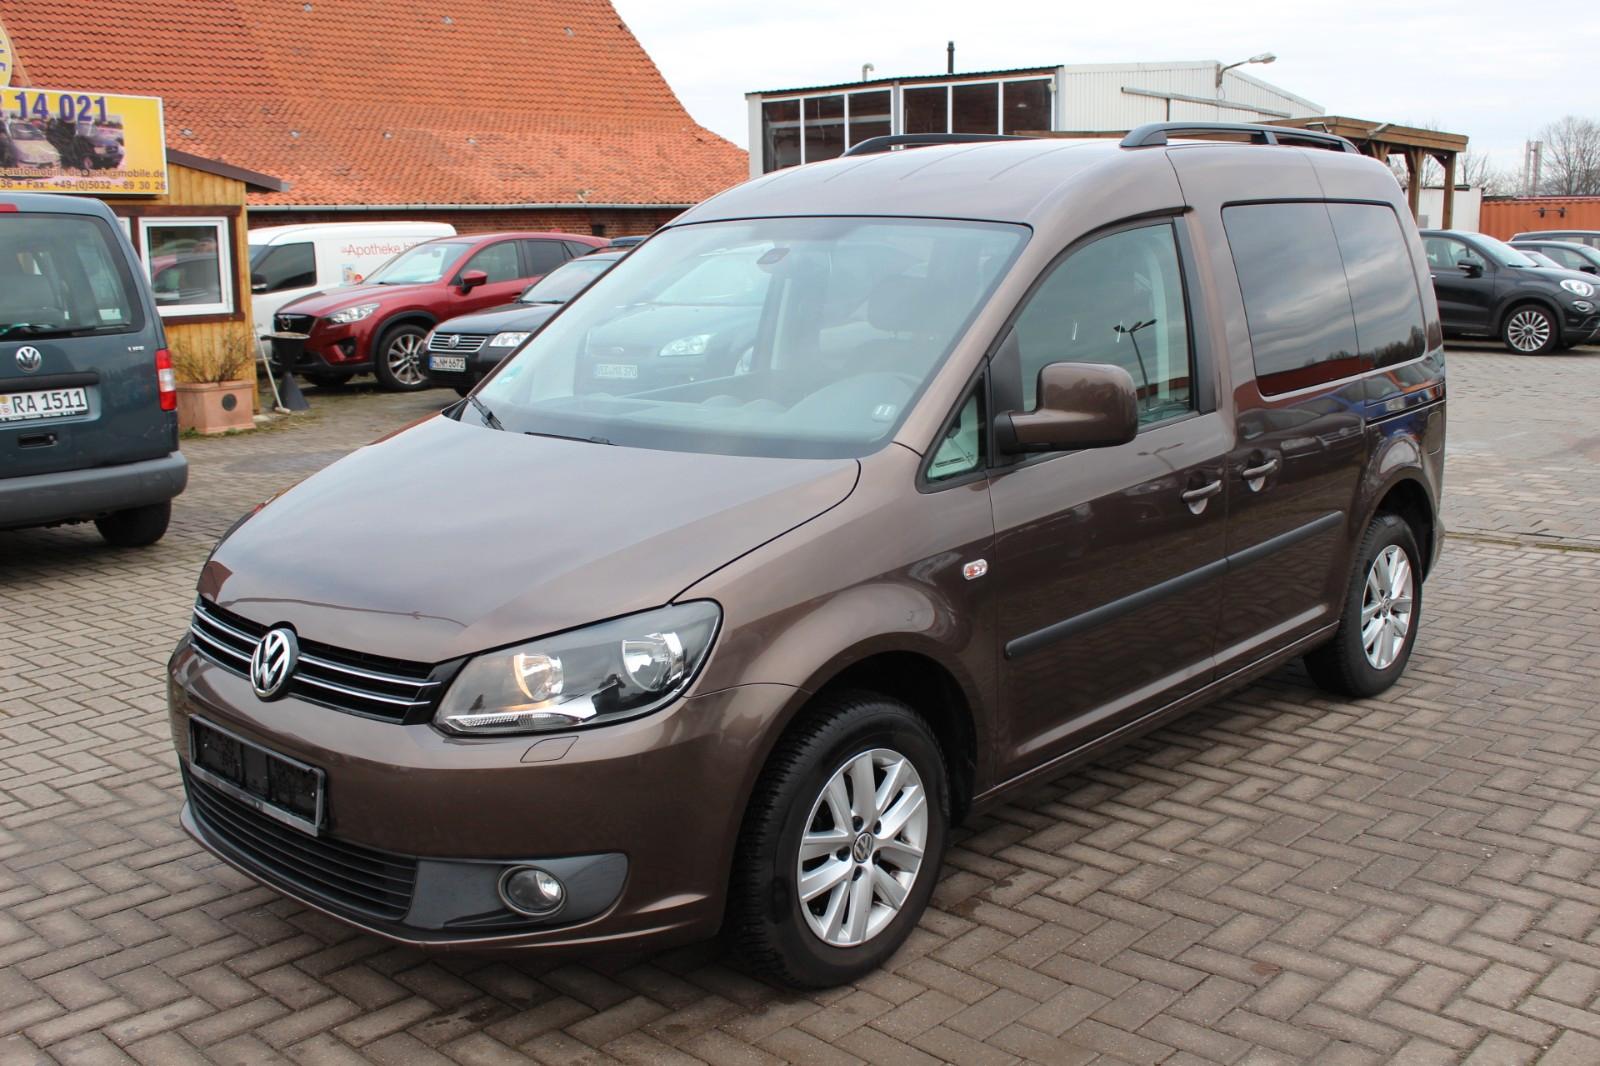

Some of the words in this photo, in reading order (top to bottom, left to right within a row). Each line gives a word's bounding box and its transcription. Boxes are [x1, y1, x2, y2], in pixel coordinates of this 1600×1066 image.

[15, 91, 49, 119] 14
[59, 94, 108, 122] 021
[347, 243, 401, 257] Apotheke
[12, 394, 38, 413] RA
[41, 390, 86, 411] 1511
